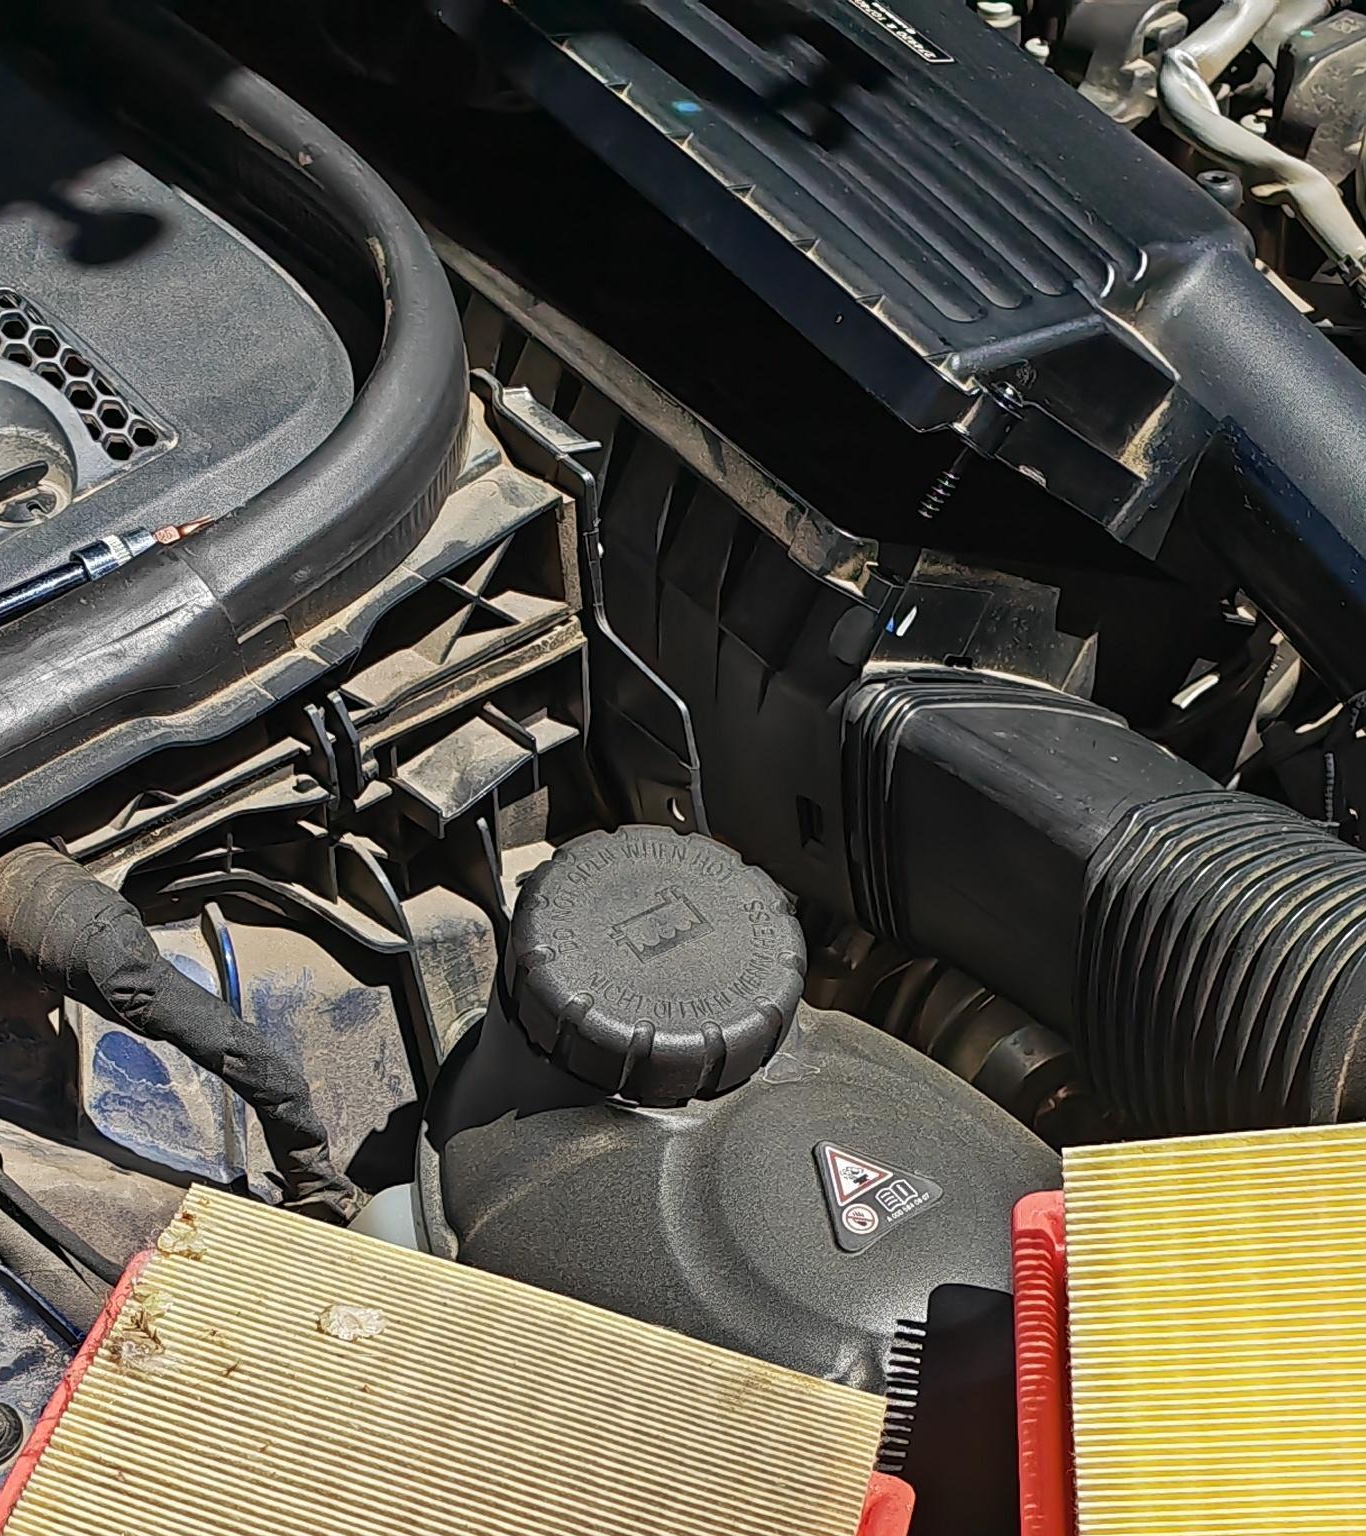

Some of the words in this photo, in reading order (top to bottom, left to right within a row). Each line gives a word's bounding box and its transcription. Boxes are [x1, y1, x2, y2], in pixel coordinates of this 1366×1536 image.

[567, 850, 617, 885] OPEN
[621, 840, 684, 863] WHEN
[692, 852, 735, 881] HOT
[552, 886, 577, 923] NOT
[552, 928, 578, 954] DO
[587, 970, 643, 1013] NICHT
[743, 899, 776, 952] HEISS
